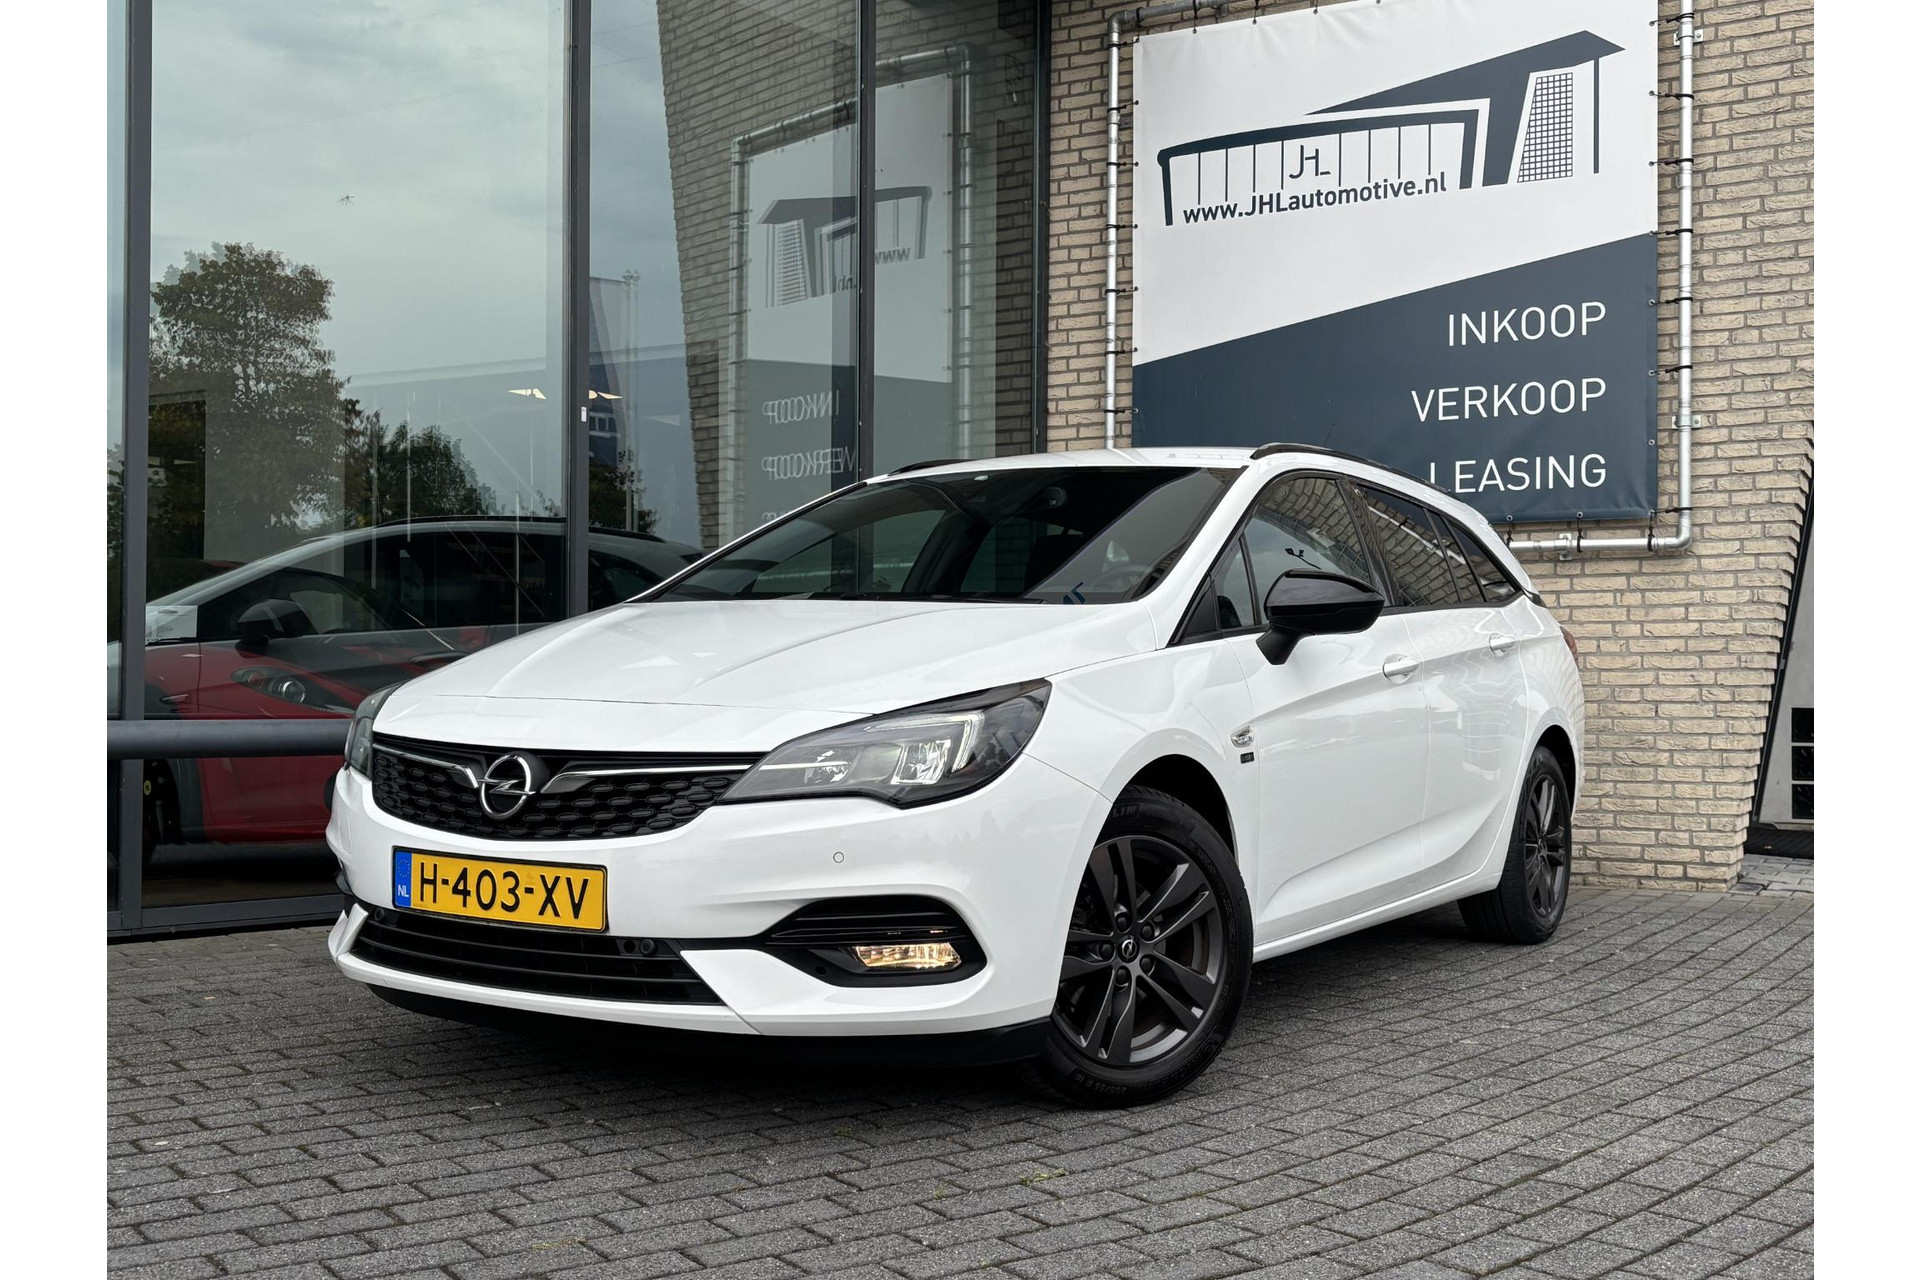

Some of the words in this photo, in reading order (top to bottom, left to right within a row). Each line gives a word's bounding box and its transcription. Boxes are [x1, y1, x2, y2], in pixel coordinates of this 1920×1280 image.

[1183, 171, 1447, 224] www.JHLautomotive.nl
[1447, 301, 1606, 347] INKOOP
[1411, 377, 1607, 422] VERKOOP
[397, 884, 410, 898] NL
[420, 862, 589, 919] H-403-XV
